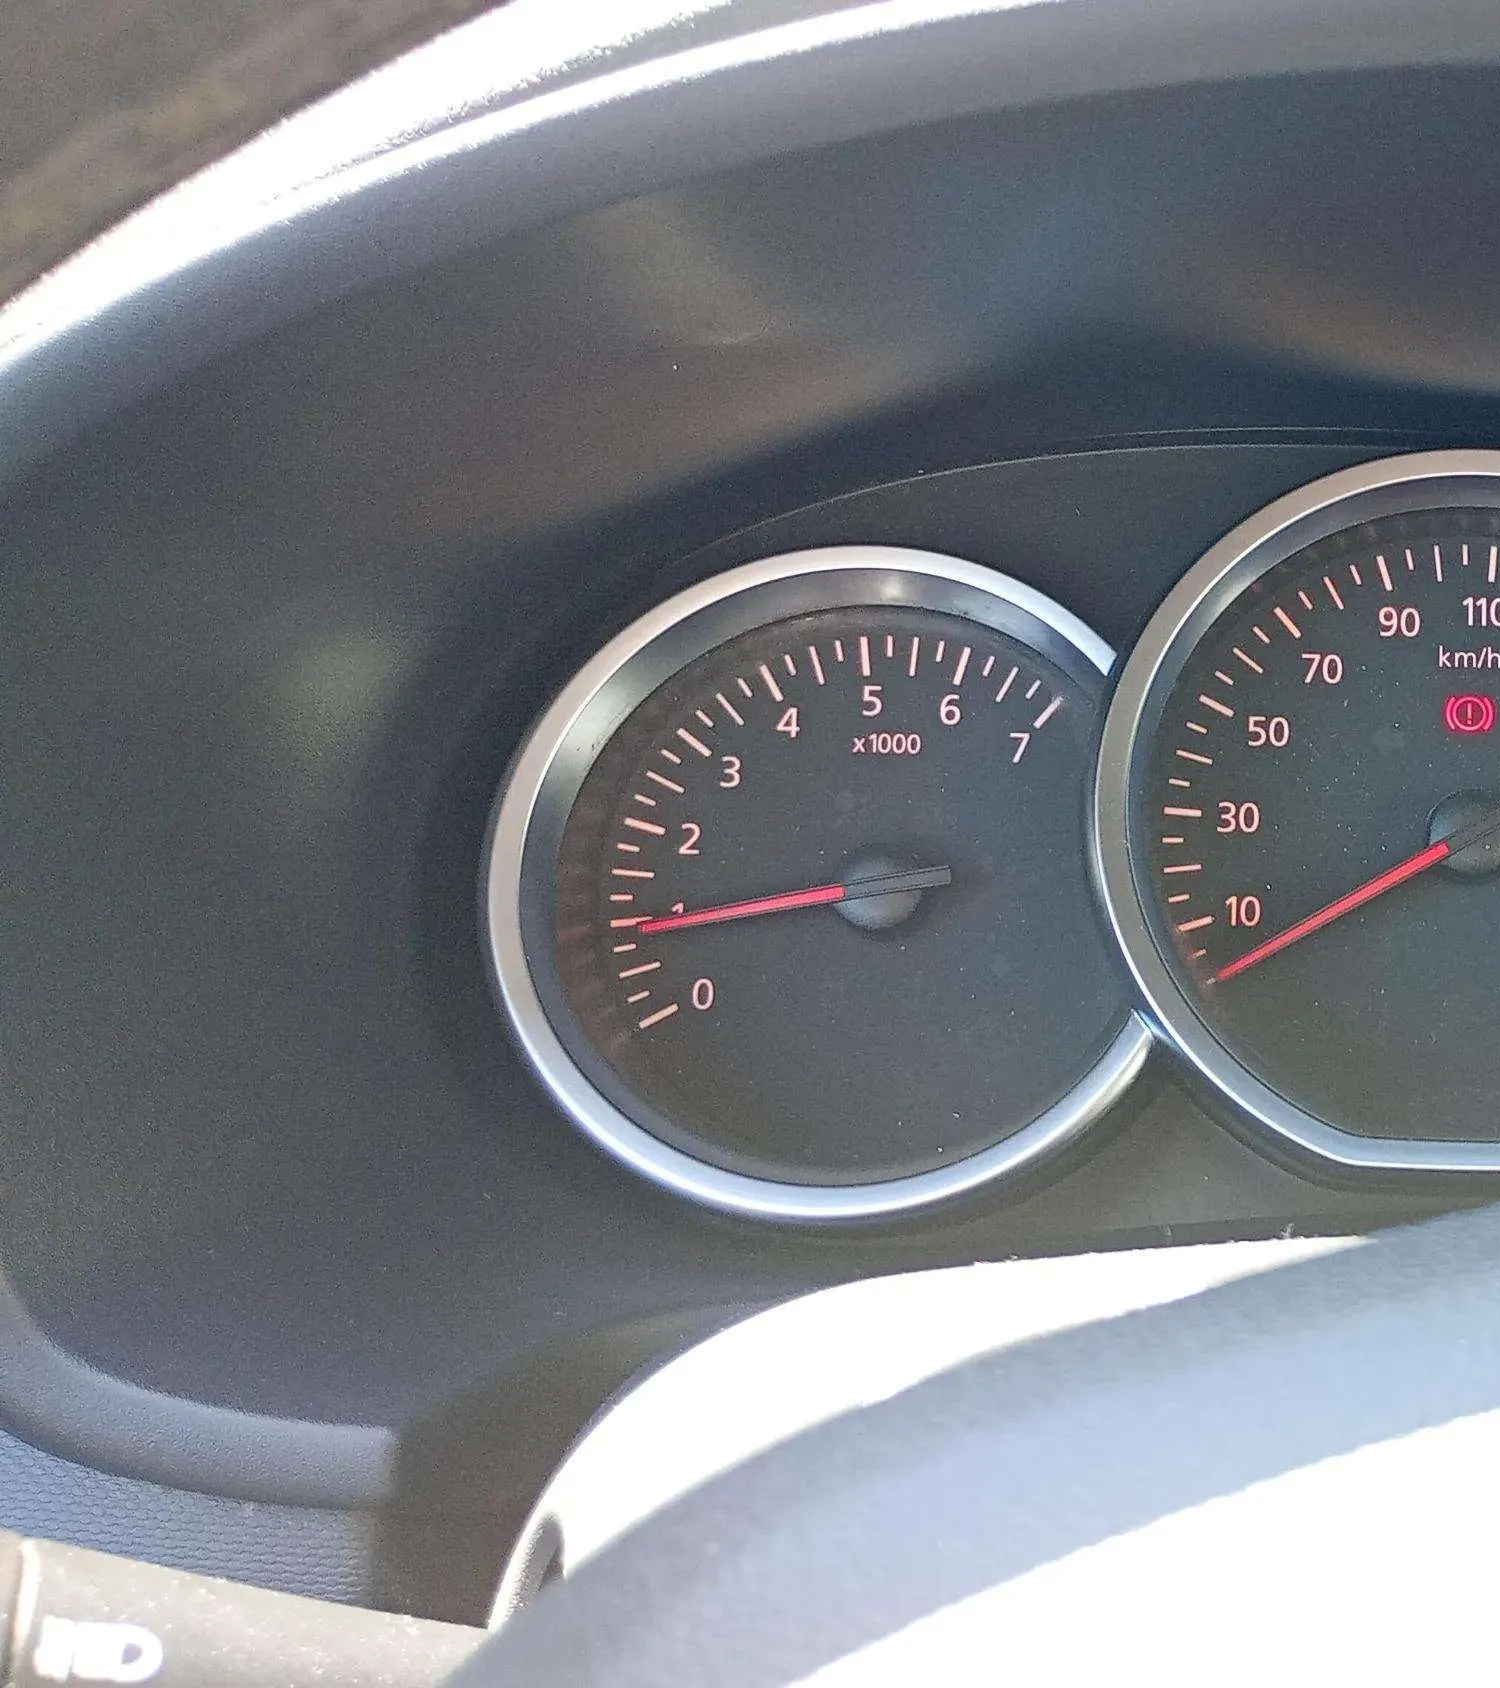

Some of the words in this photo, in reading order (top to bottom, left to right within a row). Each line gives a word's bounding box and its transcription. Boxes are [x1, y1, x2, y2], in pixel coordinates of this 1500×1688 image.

[1379, 607, 1420, 636] 90
[1302, 654, 1342, 683] 70
[1439, 646, 1500, 668] km/h
[863, 686, 882, 716] 5
[940, 695, 960, 725] 6
[777, 708, 799, 737] 4
[1249, 716, 1289, 746] 50
[853, 734, 920, 754] x1000
[1010, 733, 1029, 762] 7
[720, 757, 740, 787] 3
[1217, 802, 1259, 832] 30
[679, 823, 700, 854] 2
[1226, 896, 1260, 926] 10
[693, 979, 713, 1009] 0
